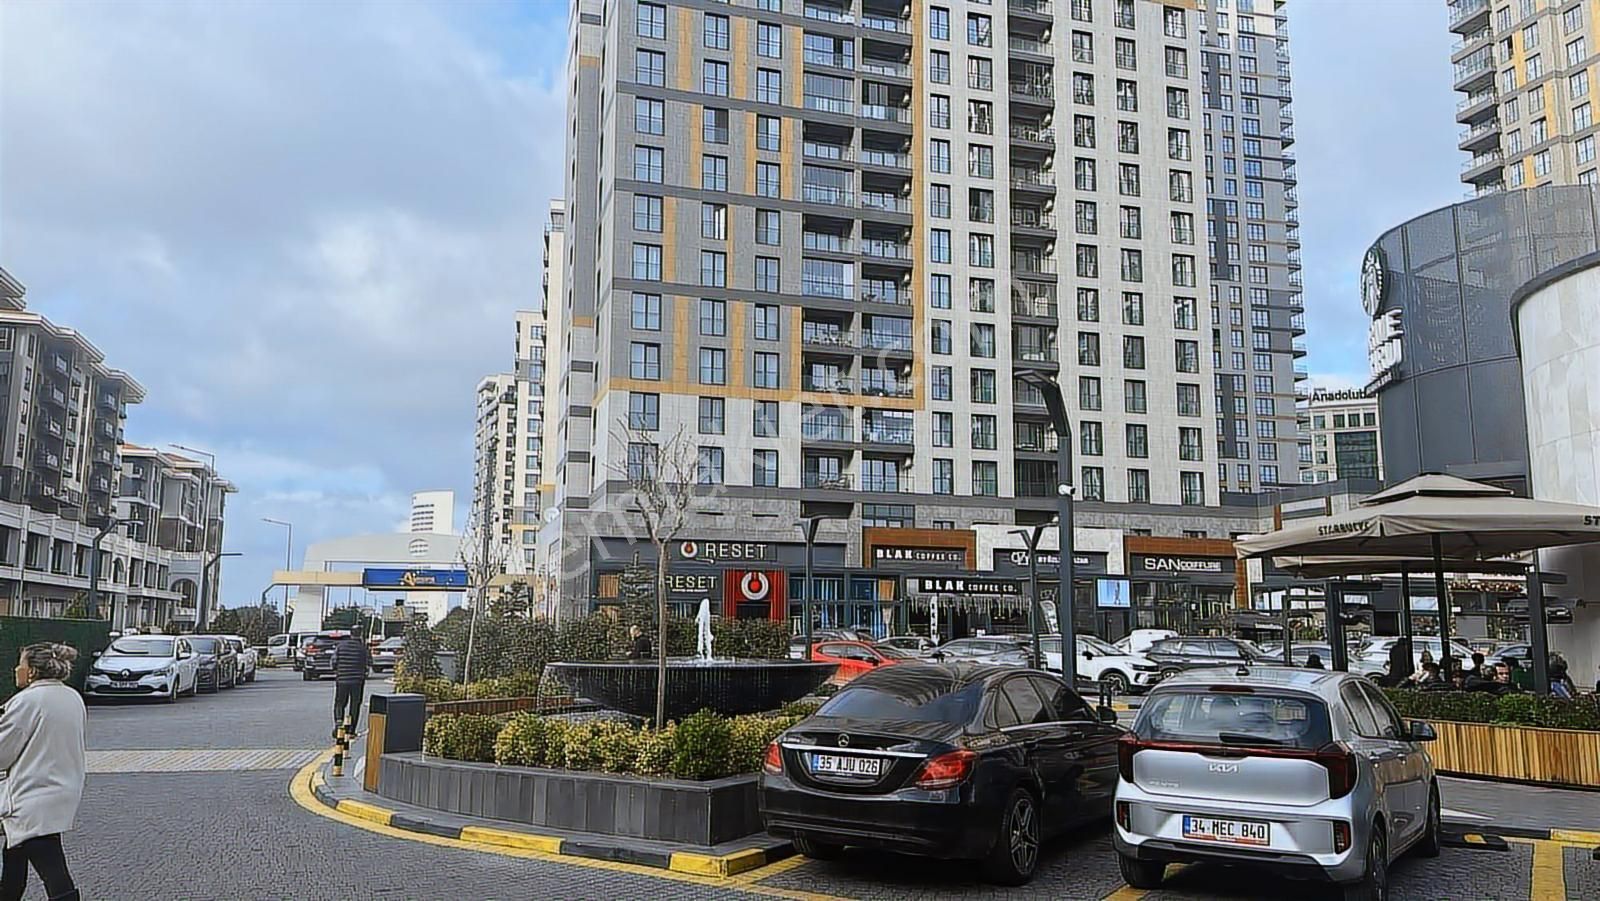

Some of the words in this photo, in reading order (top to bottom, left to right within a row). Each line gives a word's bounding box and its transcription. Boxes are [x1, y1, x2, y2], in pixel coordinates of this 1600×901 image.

[705, 542, 767, 560] RESET
[876, 548, 912, 560] BLAK
[916, 552, 945, 561] COFFEE
[666, 575, 717, 589] RESET
[925, 579, 964, 591] BLAK
[968, 583, 999, 592] COFFEE
[1003, 584, 1018, 593] CO.
[819, 756, 832, 770] 35
[836, 758, 855, 772] AJU
[859, 759, 878, 774] 026
[1191, 819, 1205, 833] 34
[1241, 823, 1265, 839] 840
